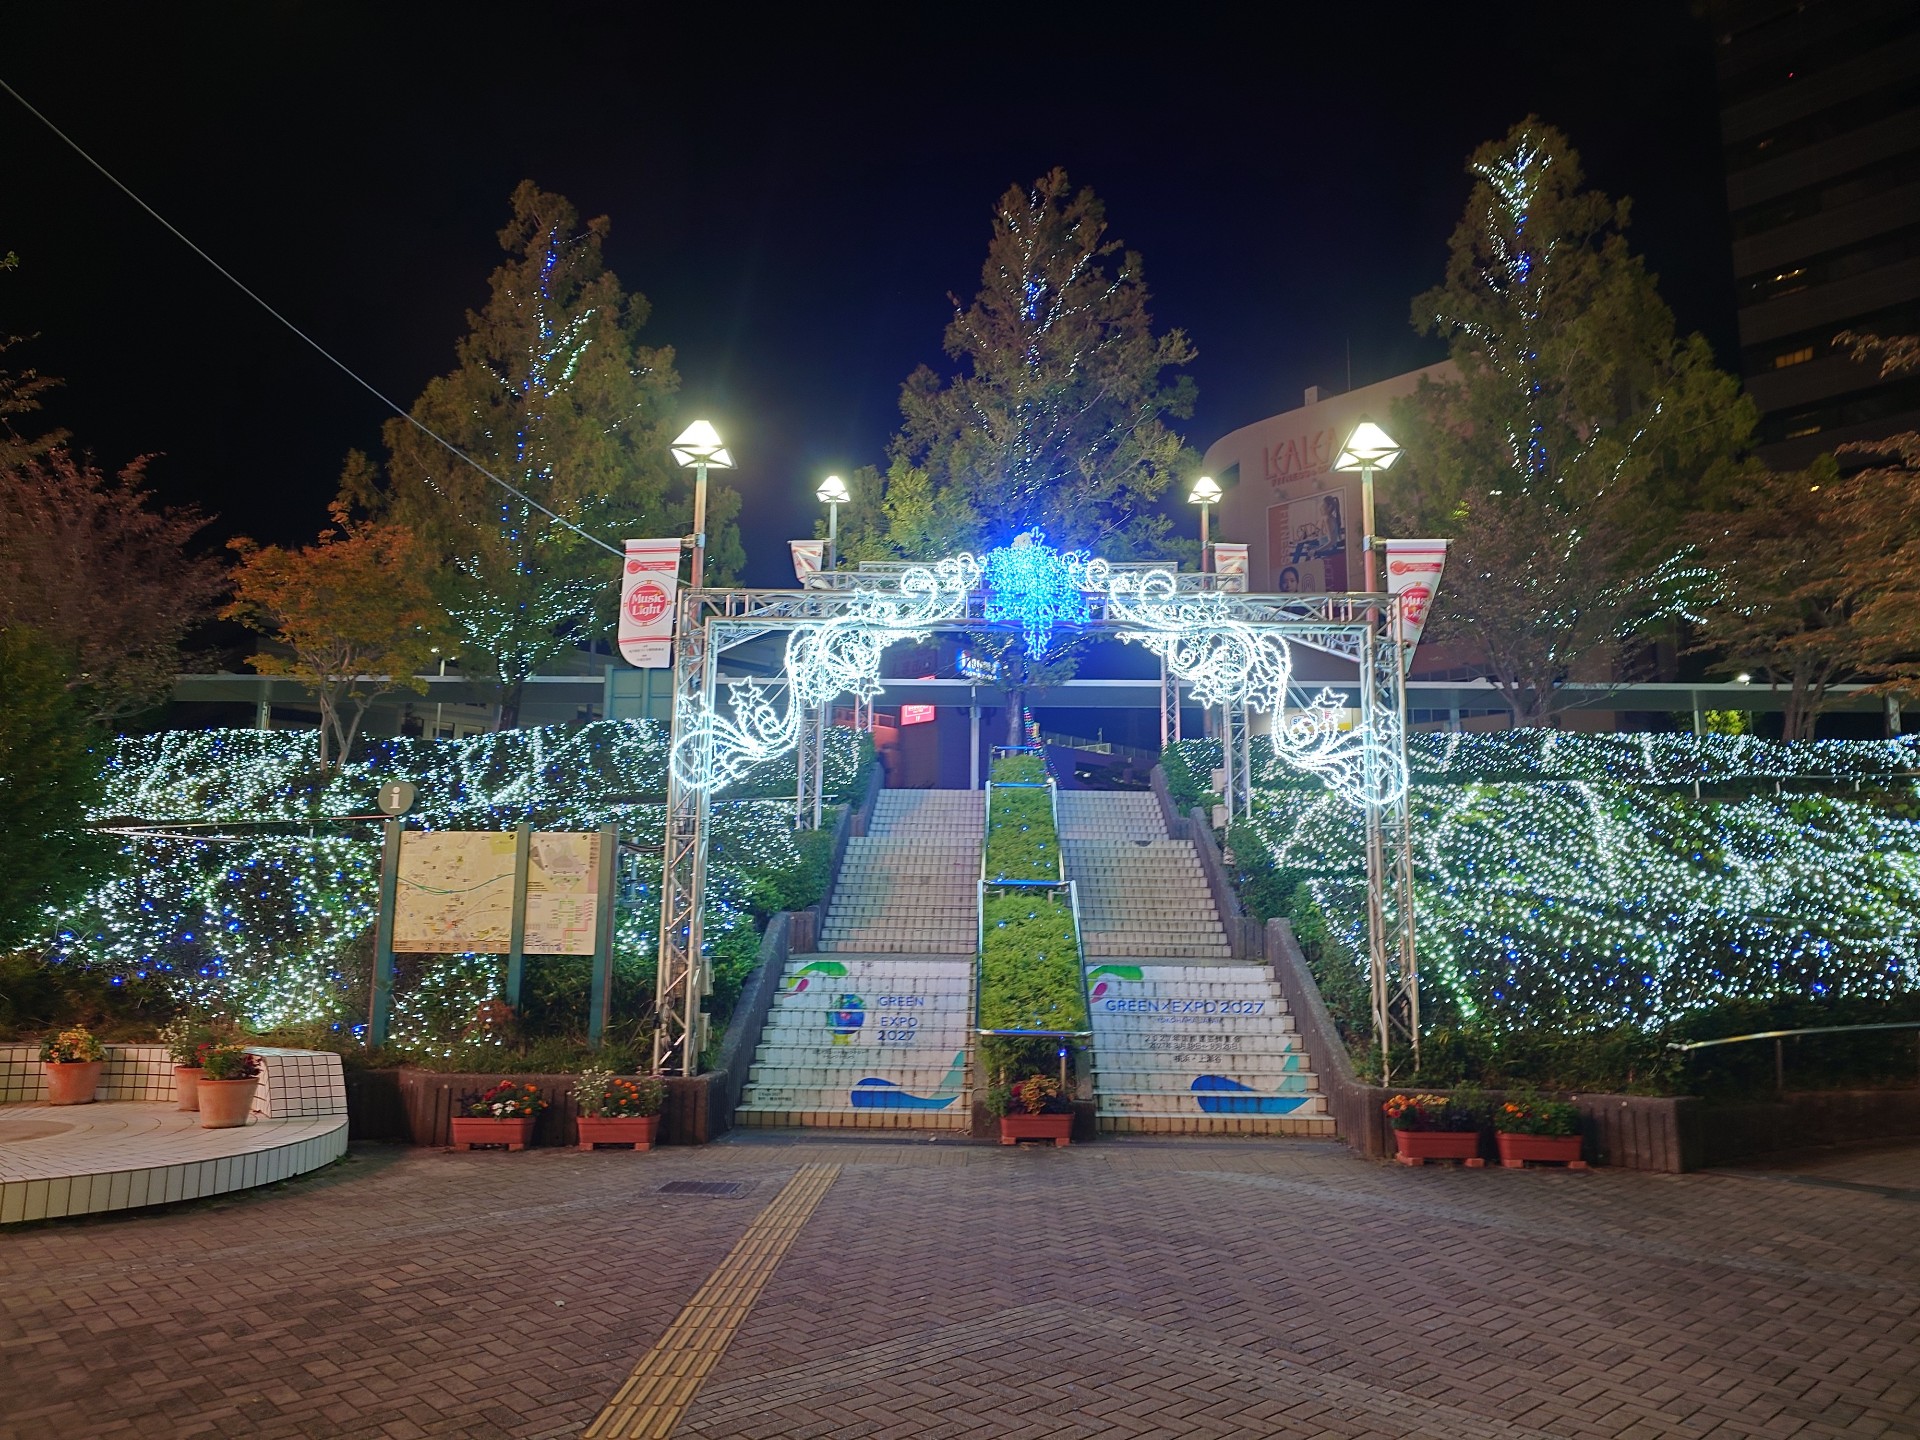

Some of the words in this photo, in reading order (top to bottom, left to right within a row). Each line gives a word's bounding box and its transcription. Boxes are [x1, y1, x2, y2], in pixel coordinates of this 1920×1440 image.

[1262, 427, 1340, 480] LEALEA
[632, 593, 664, 604] Music
[632, 603, 661, 616] Light
[878, 996, 925, 1007] GREEN
[1219, 1001, 1265, 1014] 2027
[880, 1017, 918, 1027] EXPO
[877, 1030, 916, 1041] 2027
